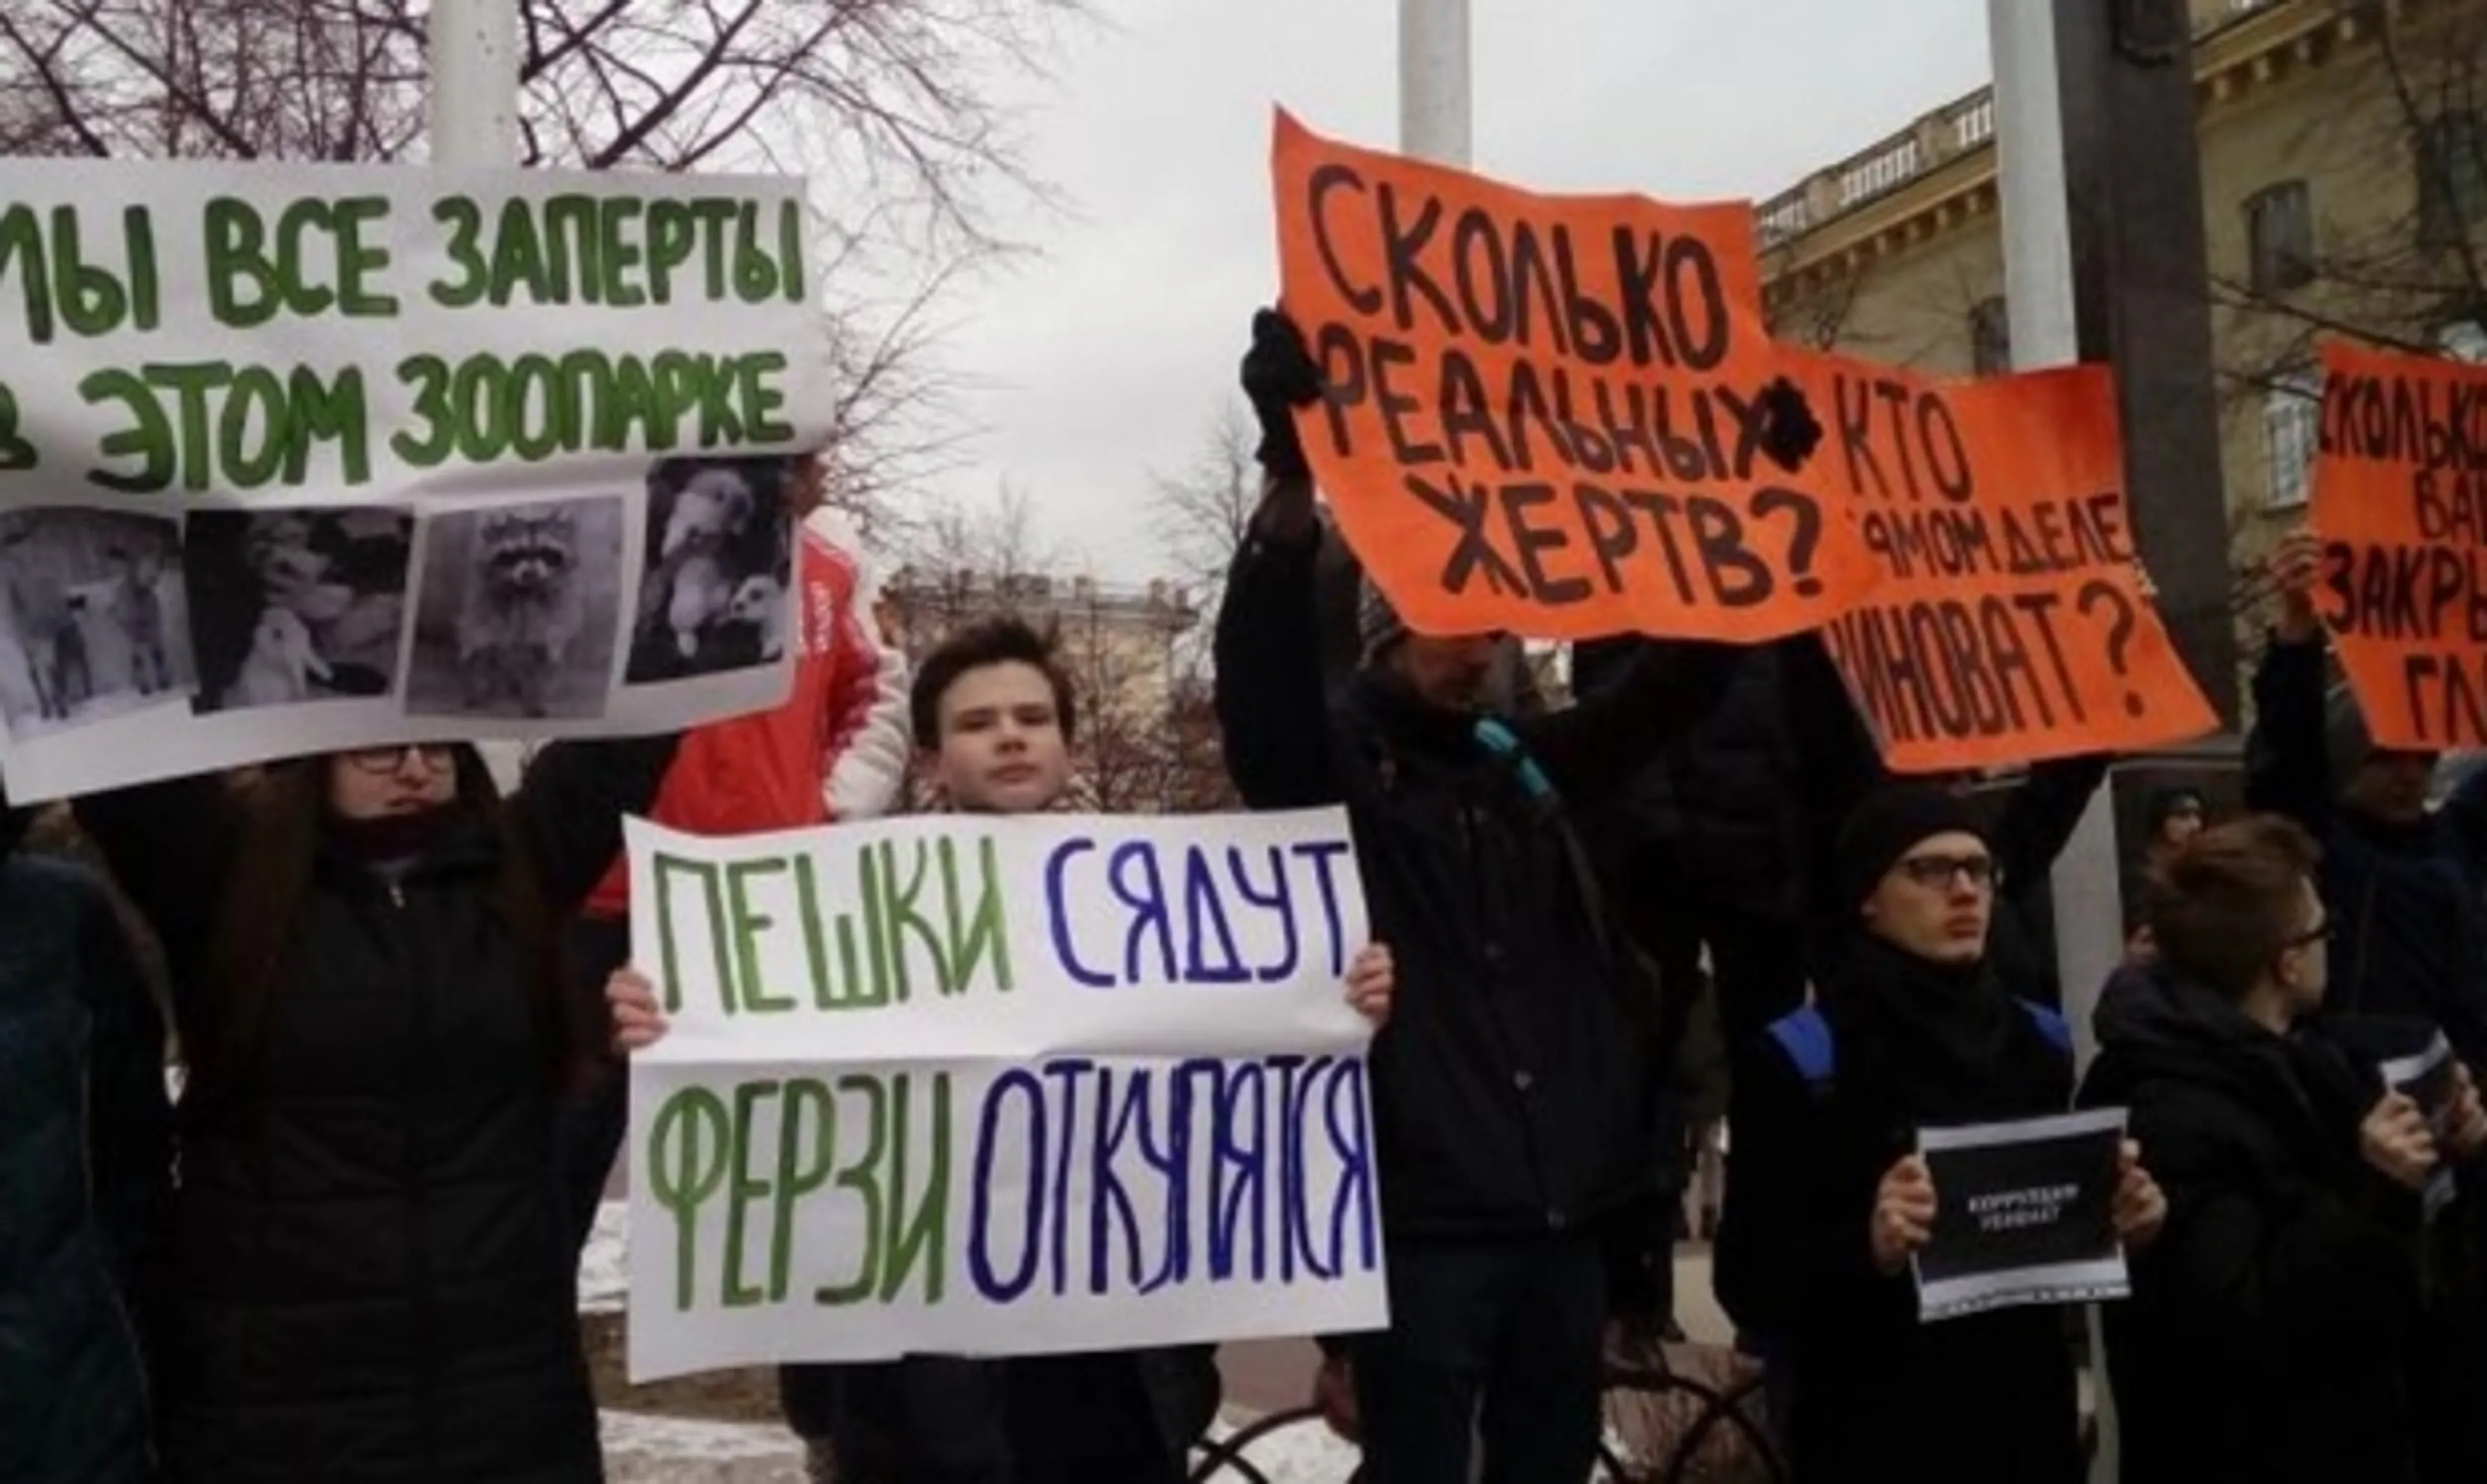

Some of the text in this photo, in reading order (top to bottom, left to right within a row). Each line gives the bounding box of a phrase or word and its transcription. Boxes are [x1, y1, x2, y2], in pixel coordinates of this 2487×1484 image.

[203, 196, 400, 328] ВСЕ
[427, 193, 807, 308] ЗАПЕРТЫ
[1308, 164, 1729, 370] СКОЛЬКО
[76, 358, 372, 494] ЭТОМ
[389, 350, 796, 467] ЗООПАРКЕ
[1316, 324, 1775, 482] РЕАЛЬНЫХ
[1834, 372, 1973, 502] КТО
[1403, 473, 1823, 607] ЖЕРТВ?
[2001, 493, 2133, 574] ДЕЛЕ
[2413, 469, 2487, 545] ВА
[2405, 654, 2487, 746] ГЛ
[653, 834, 1350, 1015] ПЕШКИ СЯДУТ
[648, 1054, 1376, 1311] ФЕРЗИ ОТКУПЯТСЯ
